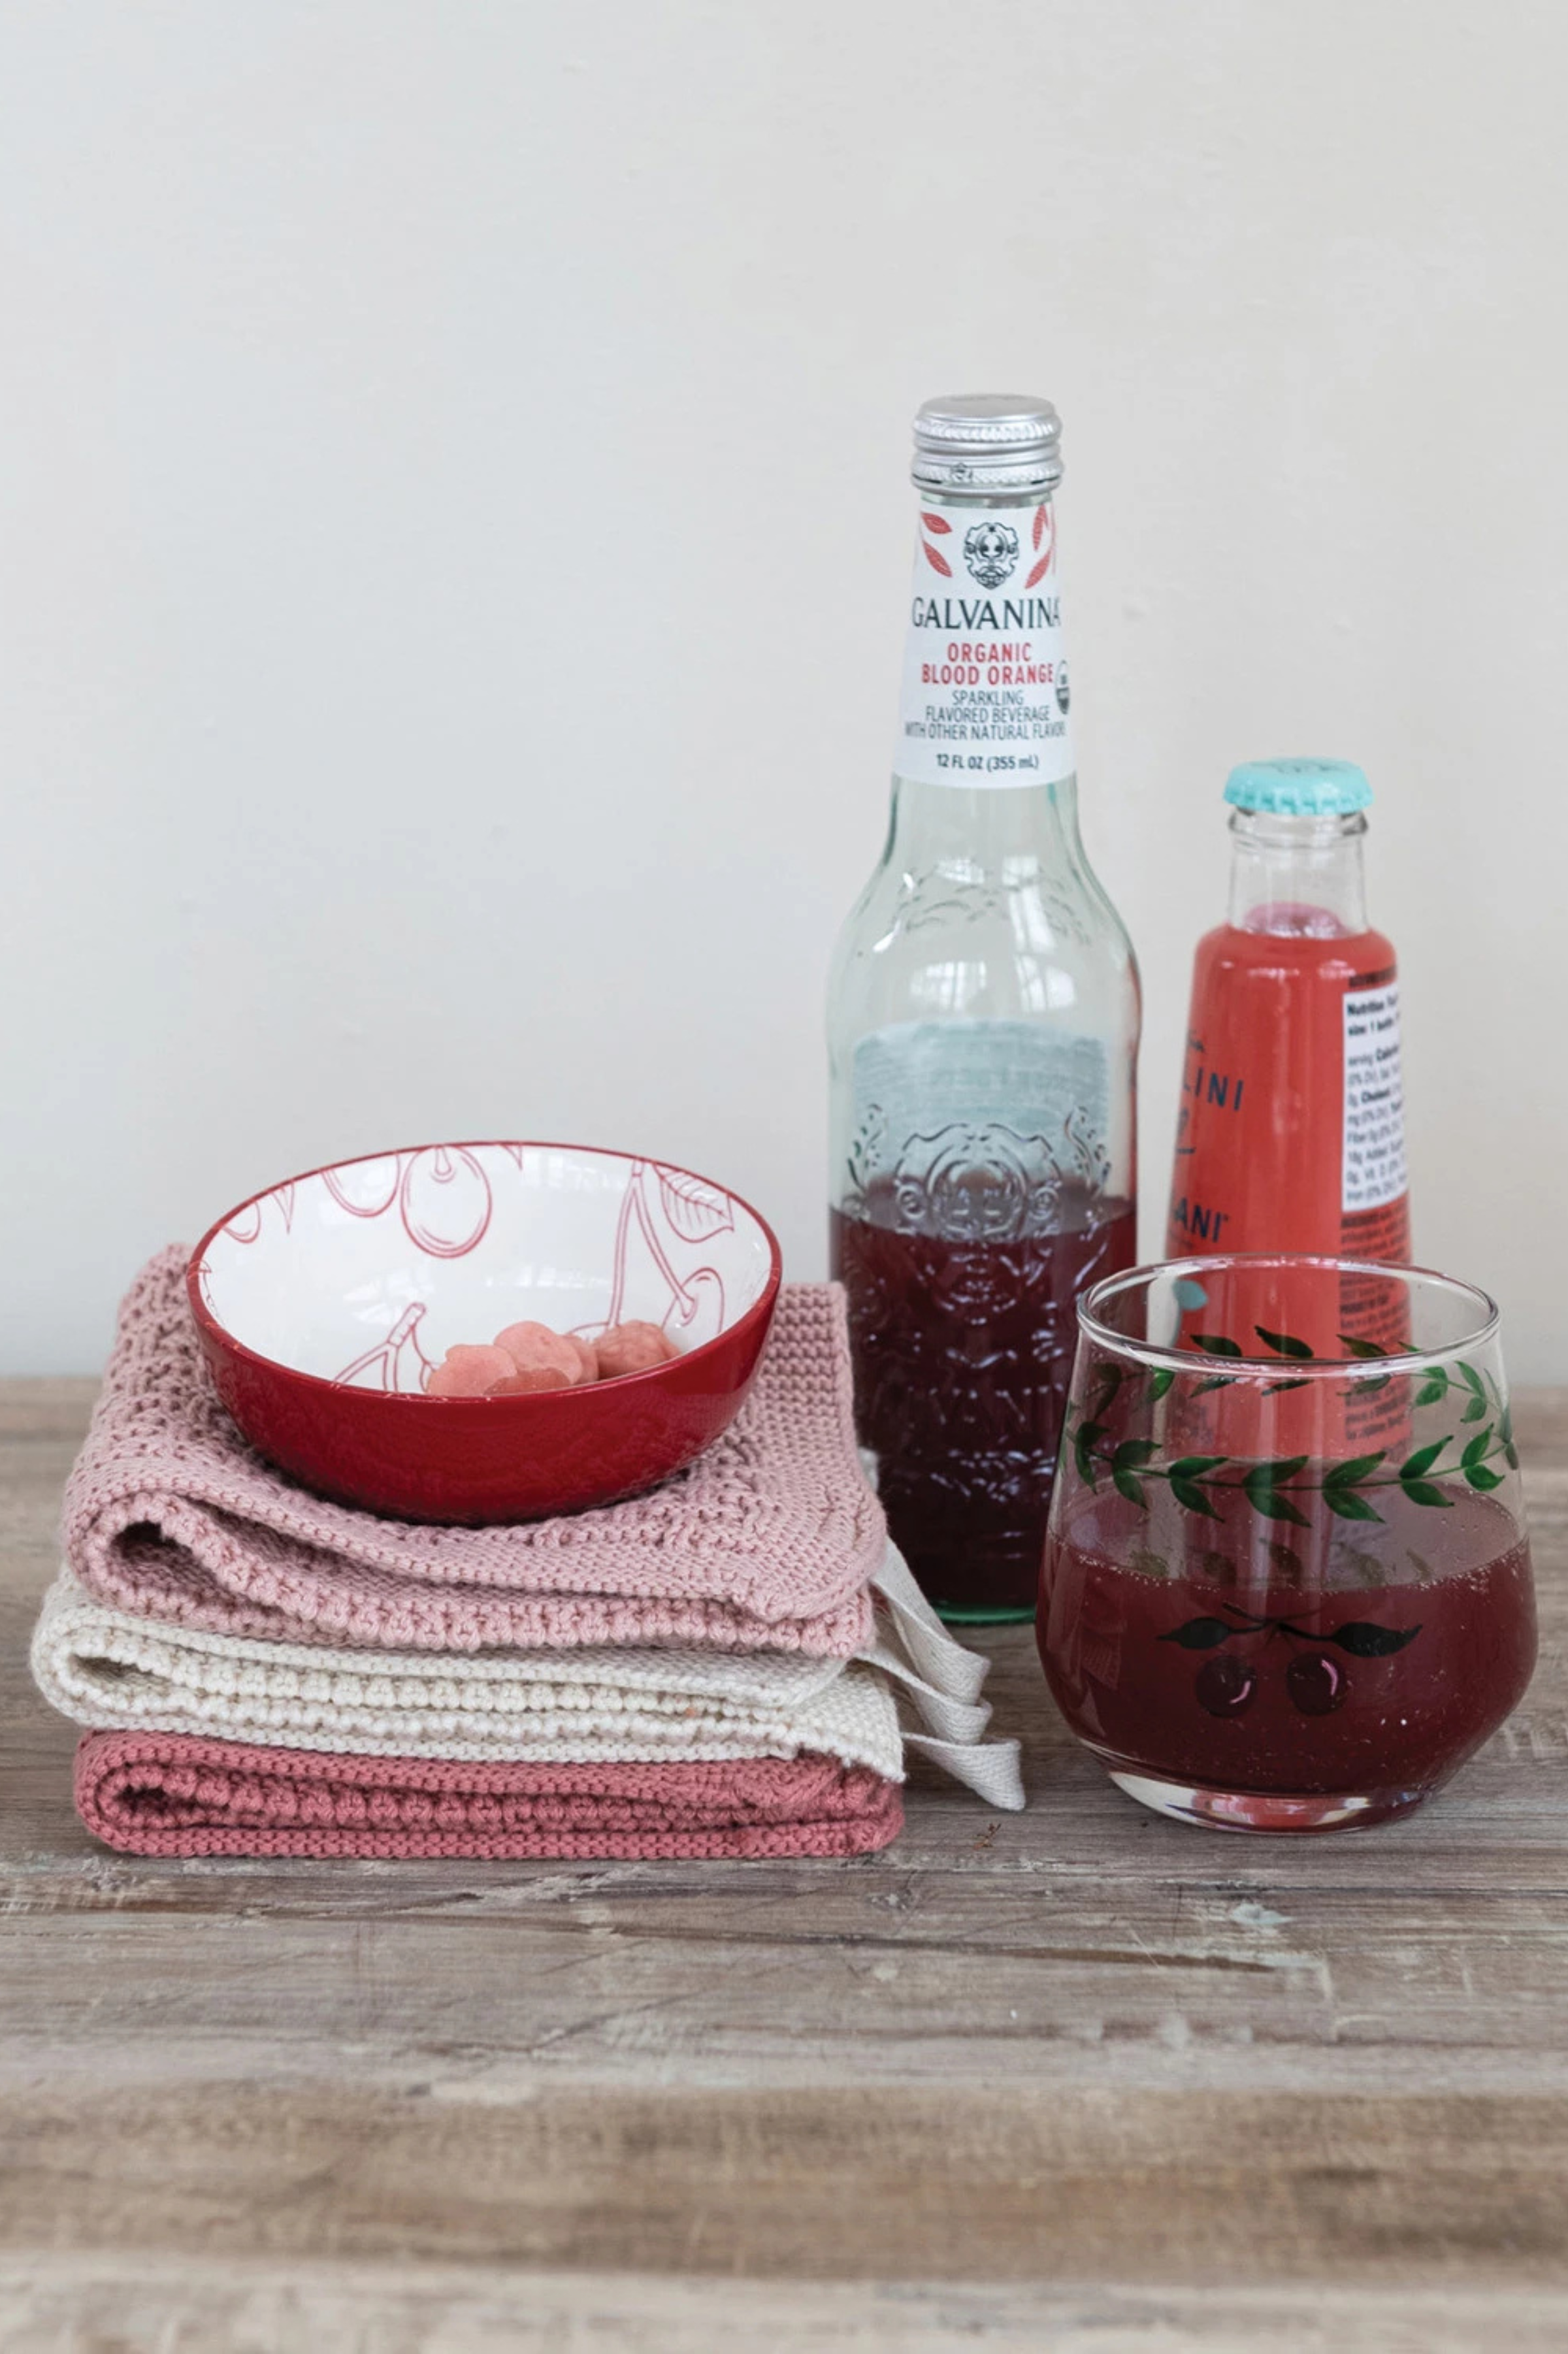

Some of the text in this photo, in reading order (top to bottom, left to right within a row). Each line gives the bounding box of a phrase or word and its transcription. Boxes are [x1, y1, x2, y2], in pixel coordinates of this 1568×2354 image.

[912, 597, 1060, 630] GALVANINA
[947, 642, 1032, 662] ORGANIC
[922, 663, 1054, 685] BLOOD ORANGE
[952, 690, 1024, 706] SPARKLING
[925, 705, 1051, 723] FLAVORED BEVERAGE
[905, 721, 926, 738] WITH
[928, 723, 968, 740] OTHER
[971, 725, 1030, 740] NATURAL
[936, 753, 948, 768] 12
[952, 755, 964, 769] FL
[968, 756, 983, 770] OZ
[987, 756, 1015, 772] (355
